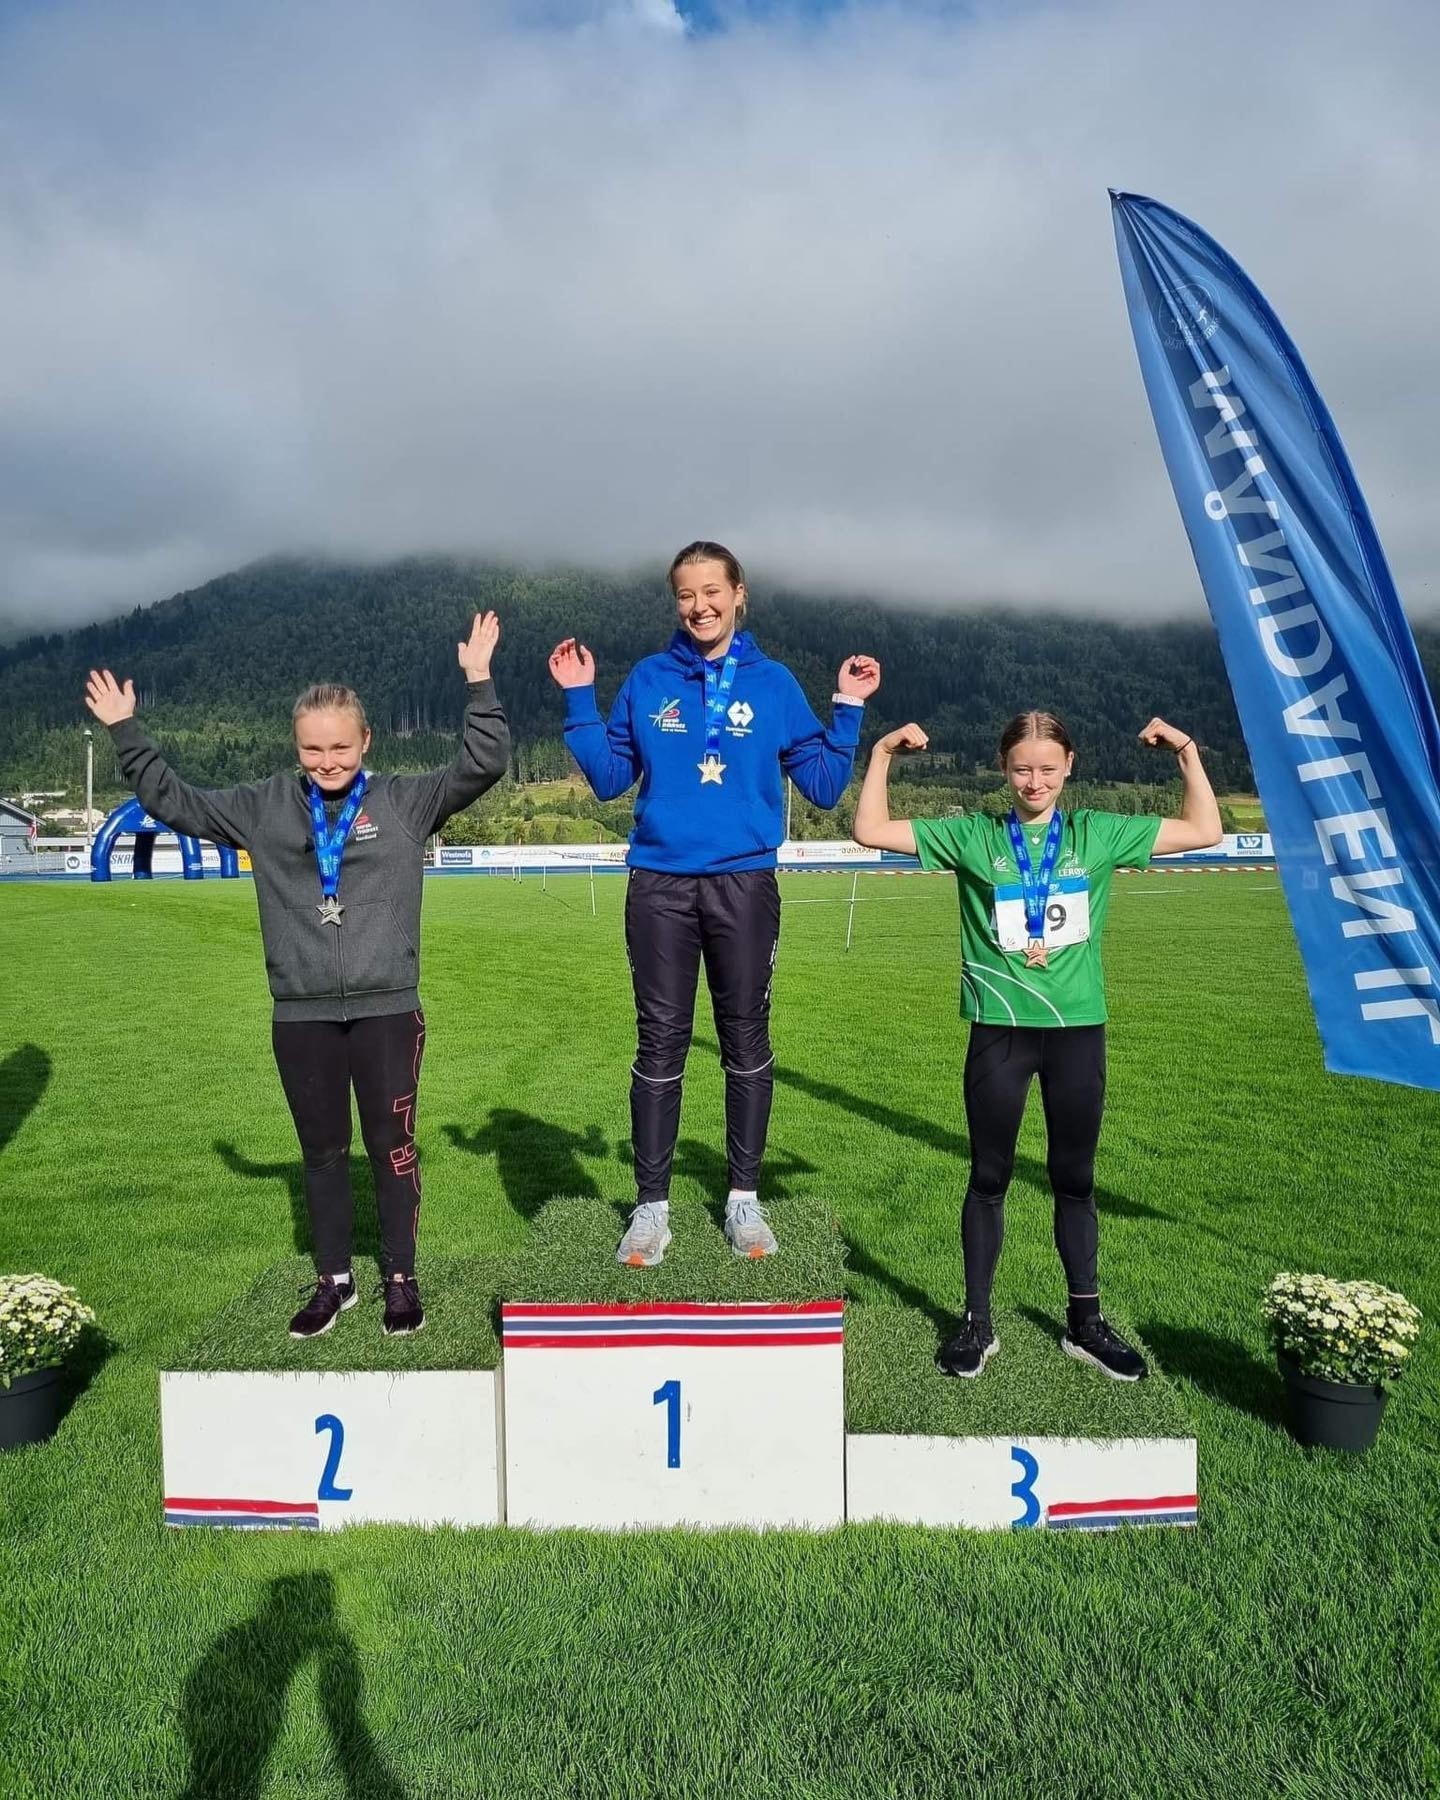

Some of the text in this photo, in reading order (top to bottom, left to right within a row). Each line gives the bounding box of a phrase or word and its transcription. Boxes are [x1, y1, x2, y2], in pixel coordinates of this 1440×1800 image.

[1058, 867, 1087, 878] LERØY
[316, 1414, 352, 1502] 2
[653, 1381, 681, 1469] 1
[1012, 1447, 1041, 1526] 3
